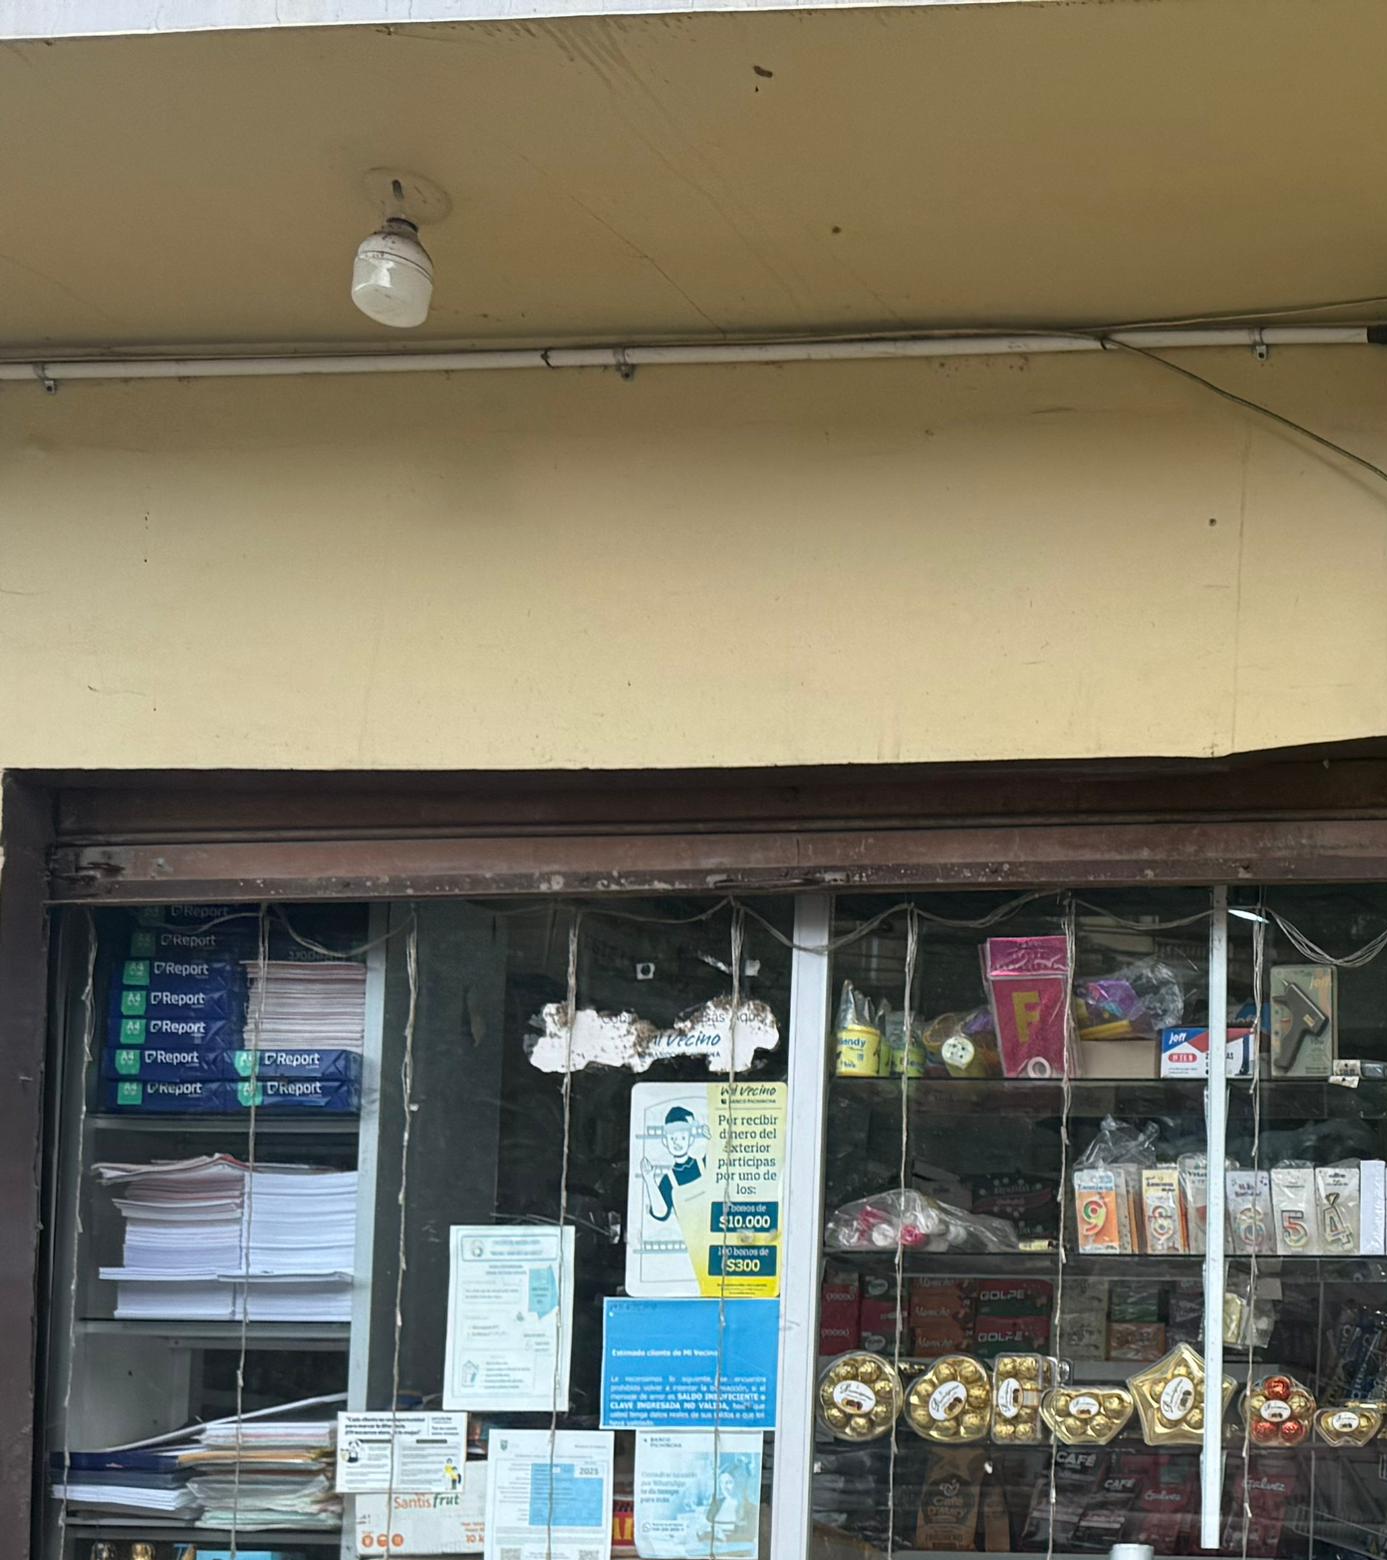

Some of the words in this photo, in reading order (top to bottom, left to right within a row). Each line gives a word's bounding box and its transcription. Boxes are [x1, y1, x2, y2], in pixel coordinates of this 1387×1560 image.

[166, 962, 208, 976] Report
[163, 992, 205, 1007] Report
[162, 1020, 205, 1035] Report
[157, 1050, 199, 1065] Report
[277, 1052, 320, 1067] Report
[280, 1081, 322, 1096] Report
[719, 1115, 737, 1126] Por
[741, 1114, 778, 1126] recibir
[760, 1128, 777, 1139] del
[716, 1172, 736, 1183] por
[739, 1172, 762, 1181] uno
[763, 1170, 777, 1181] de
[736, 1183, 756, 1195] los:
[719, 1215, 770, 1229] $10.000
[1083, 1199, 1106, 1235] 9
[1281, 1209, 1307, 1247] 5
[726, 1259, 760, 1272] $300
[1057, 1451, 1096, 1467] CAFÉ
[1104, 1478, 1136, 1490] CAFÉ
